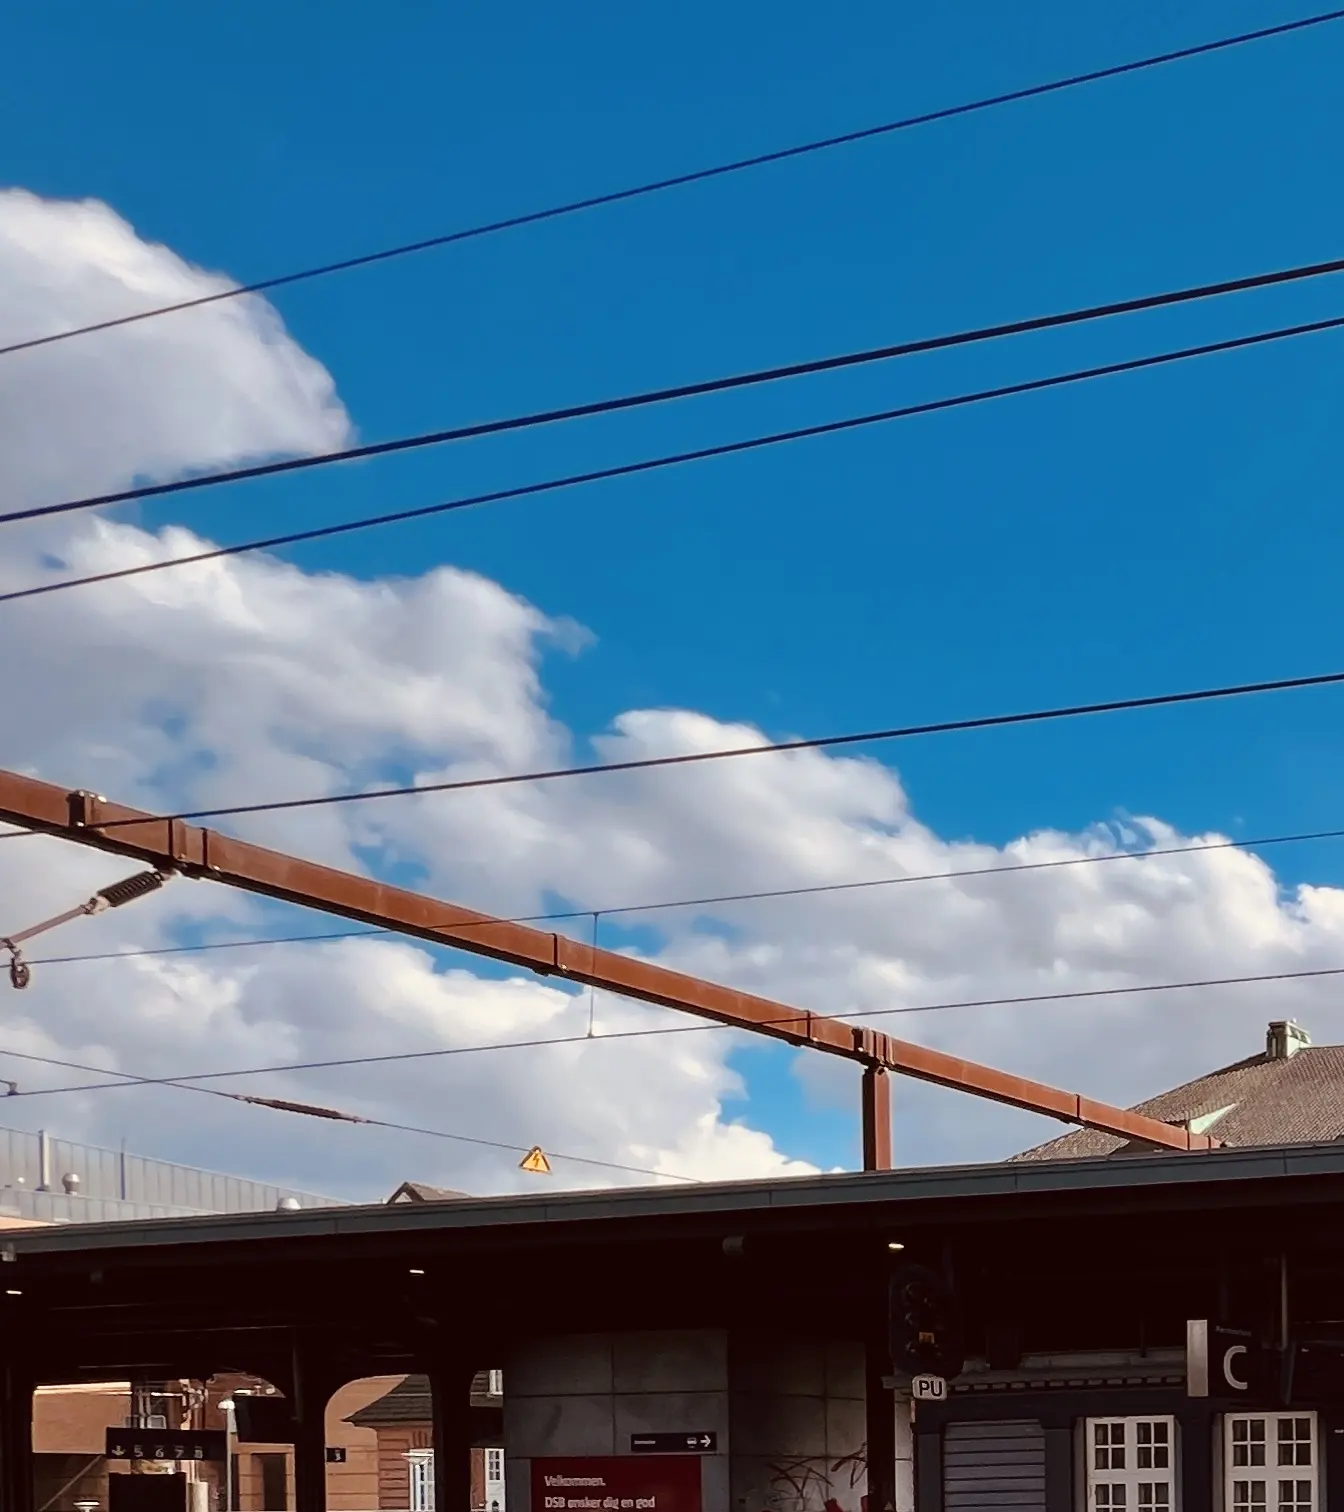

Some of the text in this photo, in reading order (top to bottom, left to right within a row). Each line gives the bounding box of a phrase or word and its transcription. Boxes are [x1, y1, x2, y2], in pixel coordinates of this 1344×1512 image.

[1223, 1345, 1248, 1390] C
[918, 1380, 943, 1396] PU
[134, 1444, 144, 1458] 5
[155, 1444, 164, 1458] 6
[174, 1445, 184, 1459] 7
[544, 1475, 606, 1487] Velkommen.
[544, 1496, 566, 1508] DSB
[603, 1496, 619, 1510] dig
[620, 1499, 634, 1508] en
[635, 1496, 656, 1510] god
